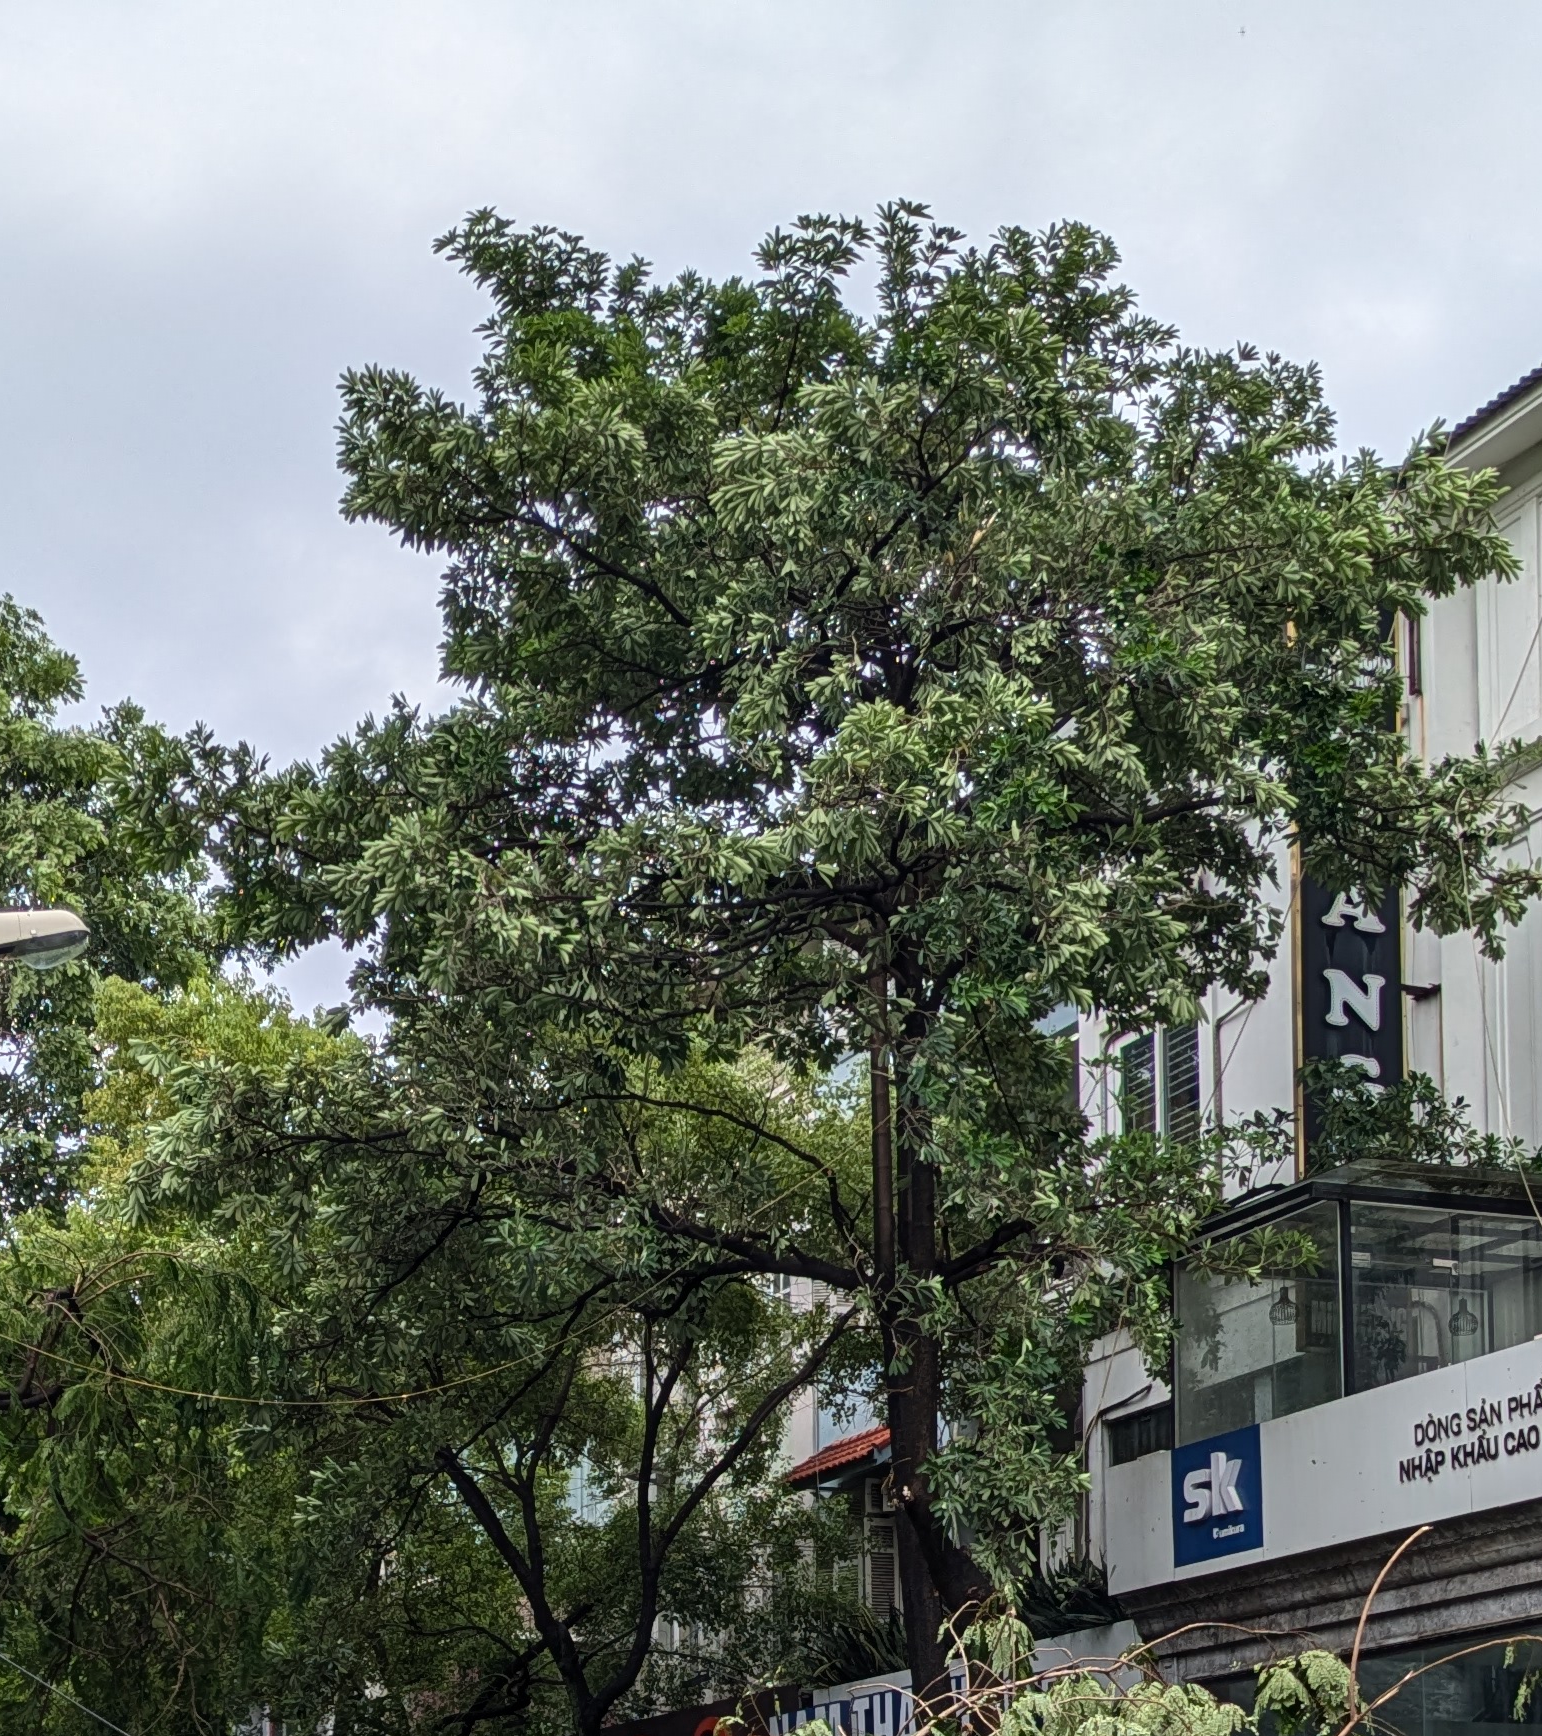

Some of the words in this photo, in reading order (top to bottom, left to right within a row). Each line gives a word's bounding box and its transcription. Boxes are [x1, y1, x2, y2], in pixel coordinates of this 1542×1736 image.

[1413, 1413, 1461, 1447] DÒNG
[1466, 1398, 1503, 1432] SẢN
[1399, 1448, 1446, 1483] NHẬP
[1451, 1429, 1499, 1470] KHẨU
[1503, 1425, 1540, 1456] CAO
